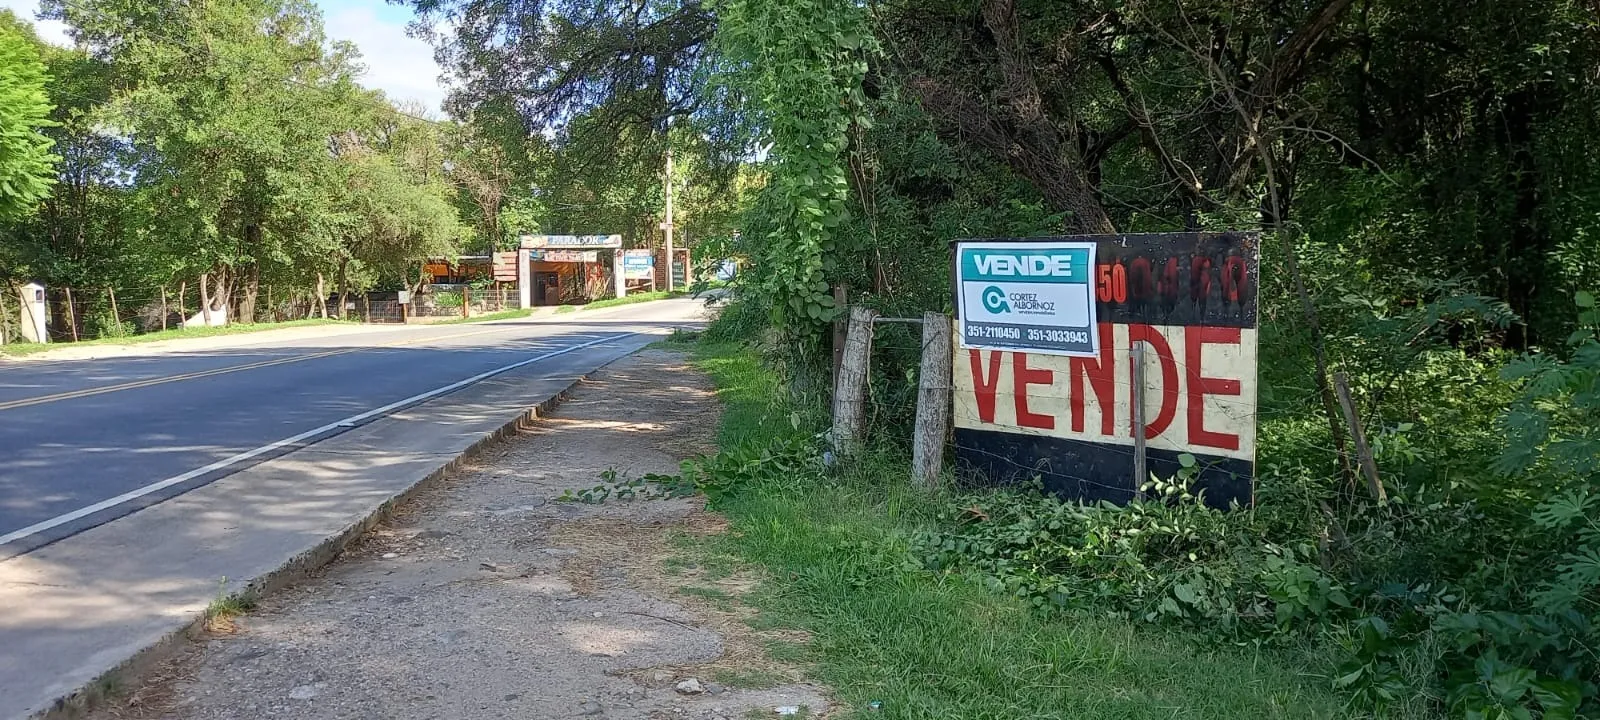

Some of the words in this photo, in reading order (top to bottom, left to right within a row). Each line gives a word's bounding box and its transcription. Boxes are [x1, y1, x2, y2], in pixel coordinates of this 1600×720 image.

[973, 254, 1072, 277] VENDE
[1009, 292, 1038, 302] CORTEZ
[1013, 300, 1055, 311] ALBORNOZ
[967, 325, 1021, 340] 351-2110450
[1027, 328, 1089, 344] 351-3033943
[969, 322, 1242, 451] VENDE
